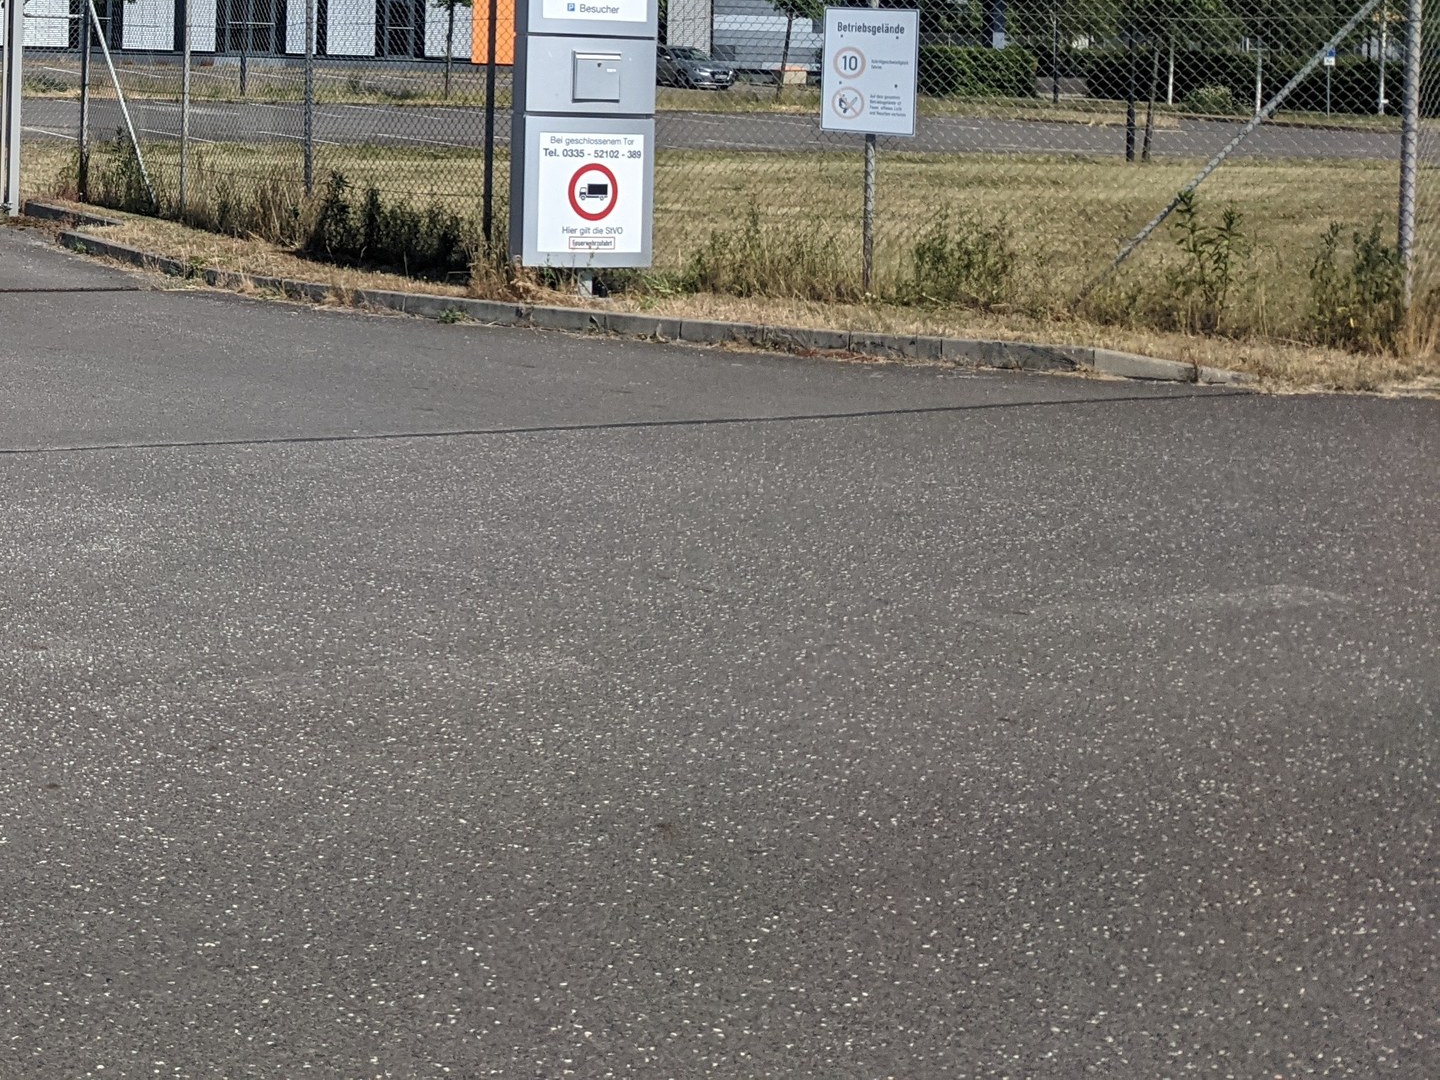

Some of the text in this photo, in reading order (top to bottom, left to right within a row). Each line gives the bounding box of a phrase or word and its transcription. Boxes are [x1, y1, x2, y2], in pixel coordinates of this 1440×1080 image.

[579, 3, 620, 14] Besucher
[837, 21, 905, 36] Betriebsgelände
[842, 55, 858, 71] 10
[550, 136, 635, 147] Bei geschlossenem Tor
[543, 148, 560, 158] Tel.
[562, 148, 585, 158] 0335
[594, 149, 620, 159] 52102
[627, 150, 642, 160] 389
[561, 226, 624, 236] Hier gilt die StVO
